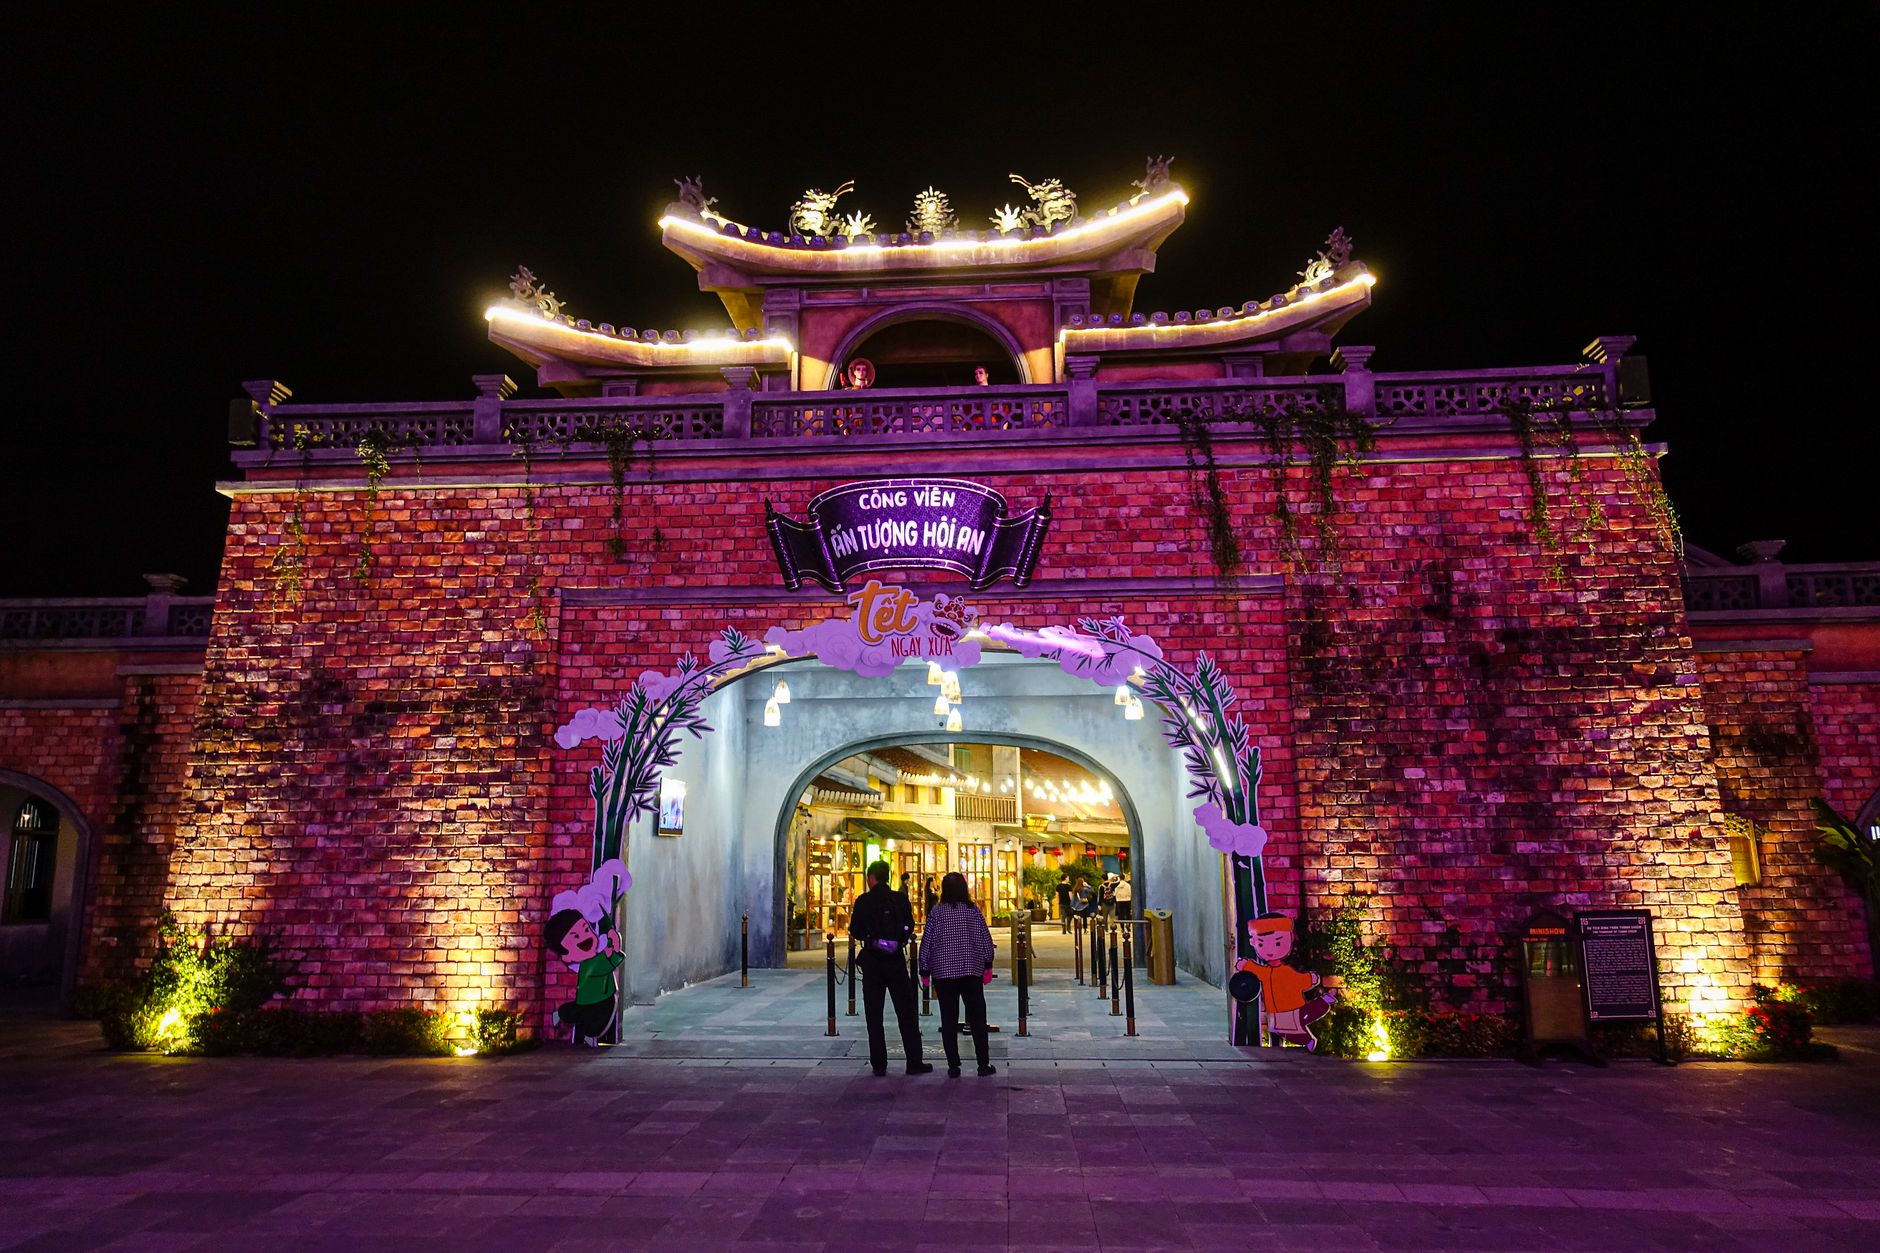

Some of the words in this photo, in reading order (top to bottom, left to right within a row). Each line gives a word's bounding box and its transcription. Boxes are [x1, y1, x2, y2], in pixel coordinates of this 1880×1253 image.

[859, 489, 908, 510] CÔNG
[913, 486, 956, 507] VIÊN
[831, 523, 859, 559] ẤN
[857, 517, 919, 555] TƯỢNG
[922, 515, 957, 555] HỘI
[956, 525, 986, 556] AN
[850, 581, 918, 643] Tết
[928, 634, 953, 657] XƯA
